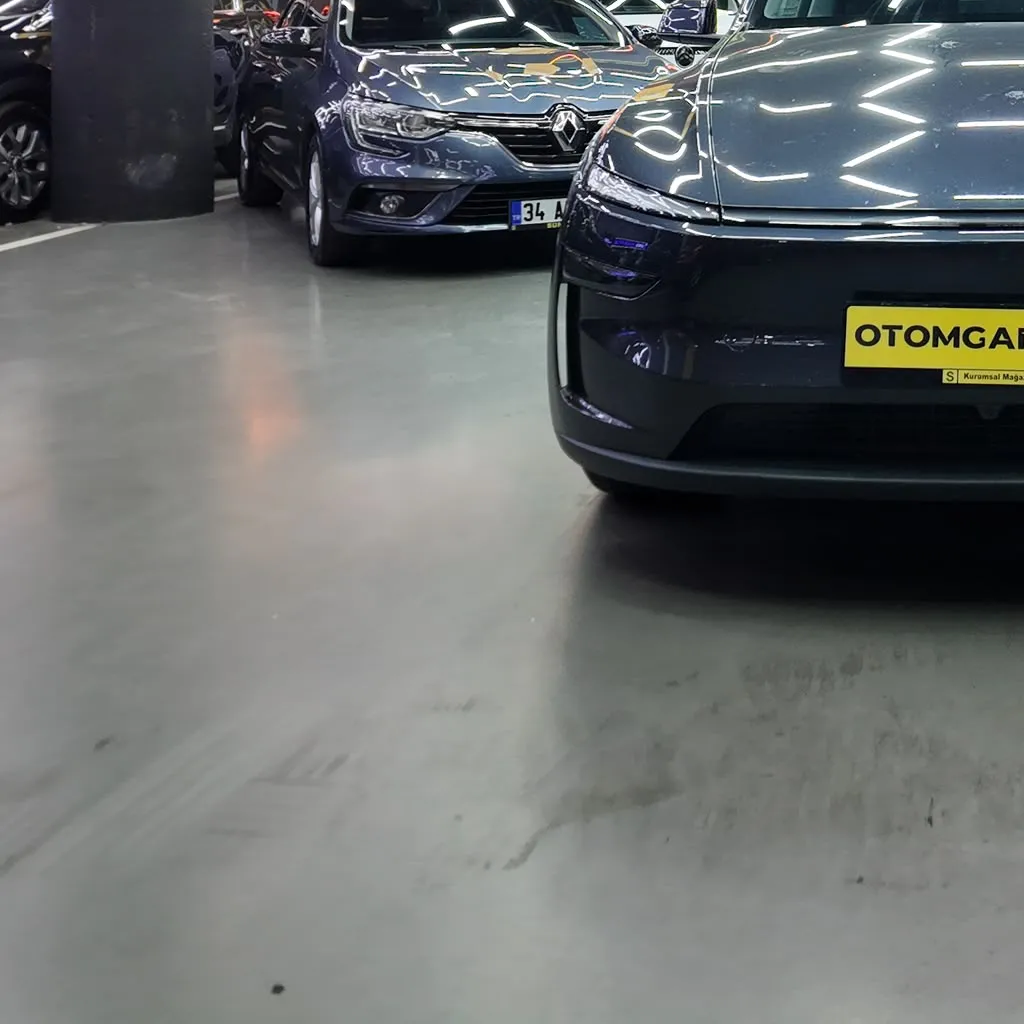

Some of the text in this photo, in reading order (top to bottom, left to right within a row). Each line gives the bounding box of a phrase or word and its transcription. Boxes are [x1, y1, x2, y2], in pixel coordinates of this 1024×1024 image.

[523, 202, 545, 222] 34
[946, 371, 954, 382] S
[963, 372, 1000, 381] Kurumsal
